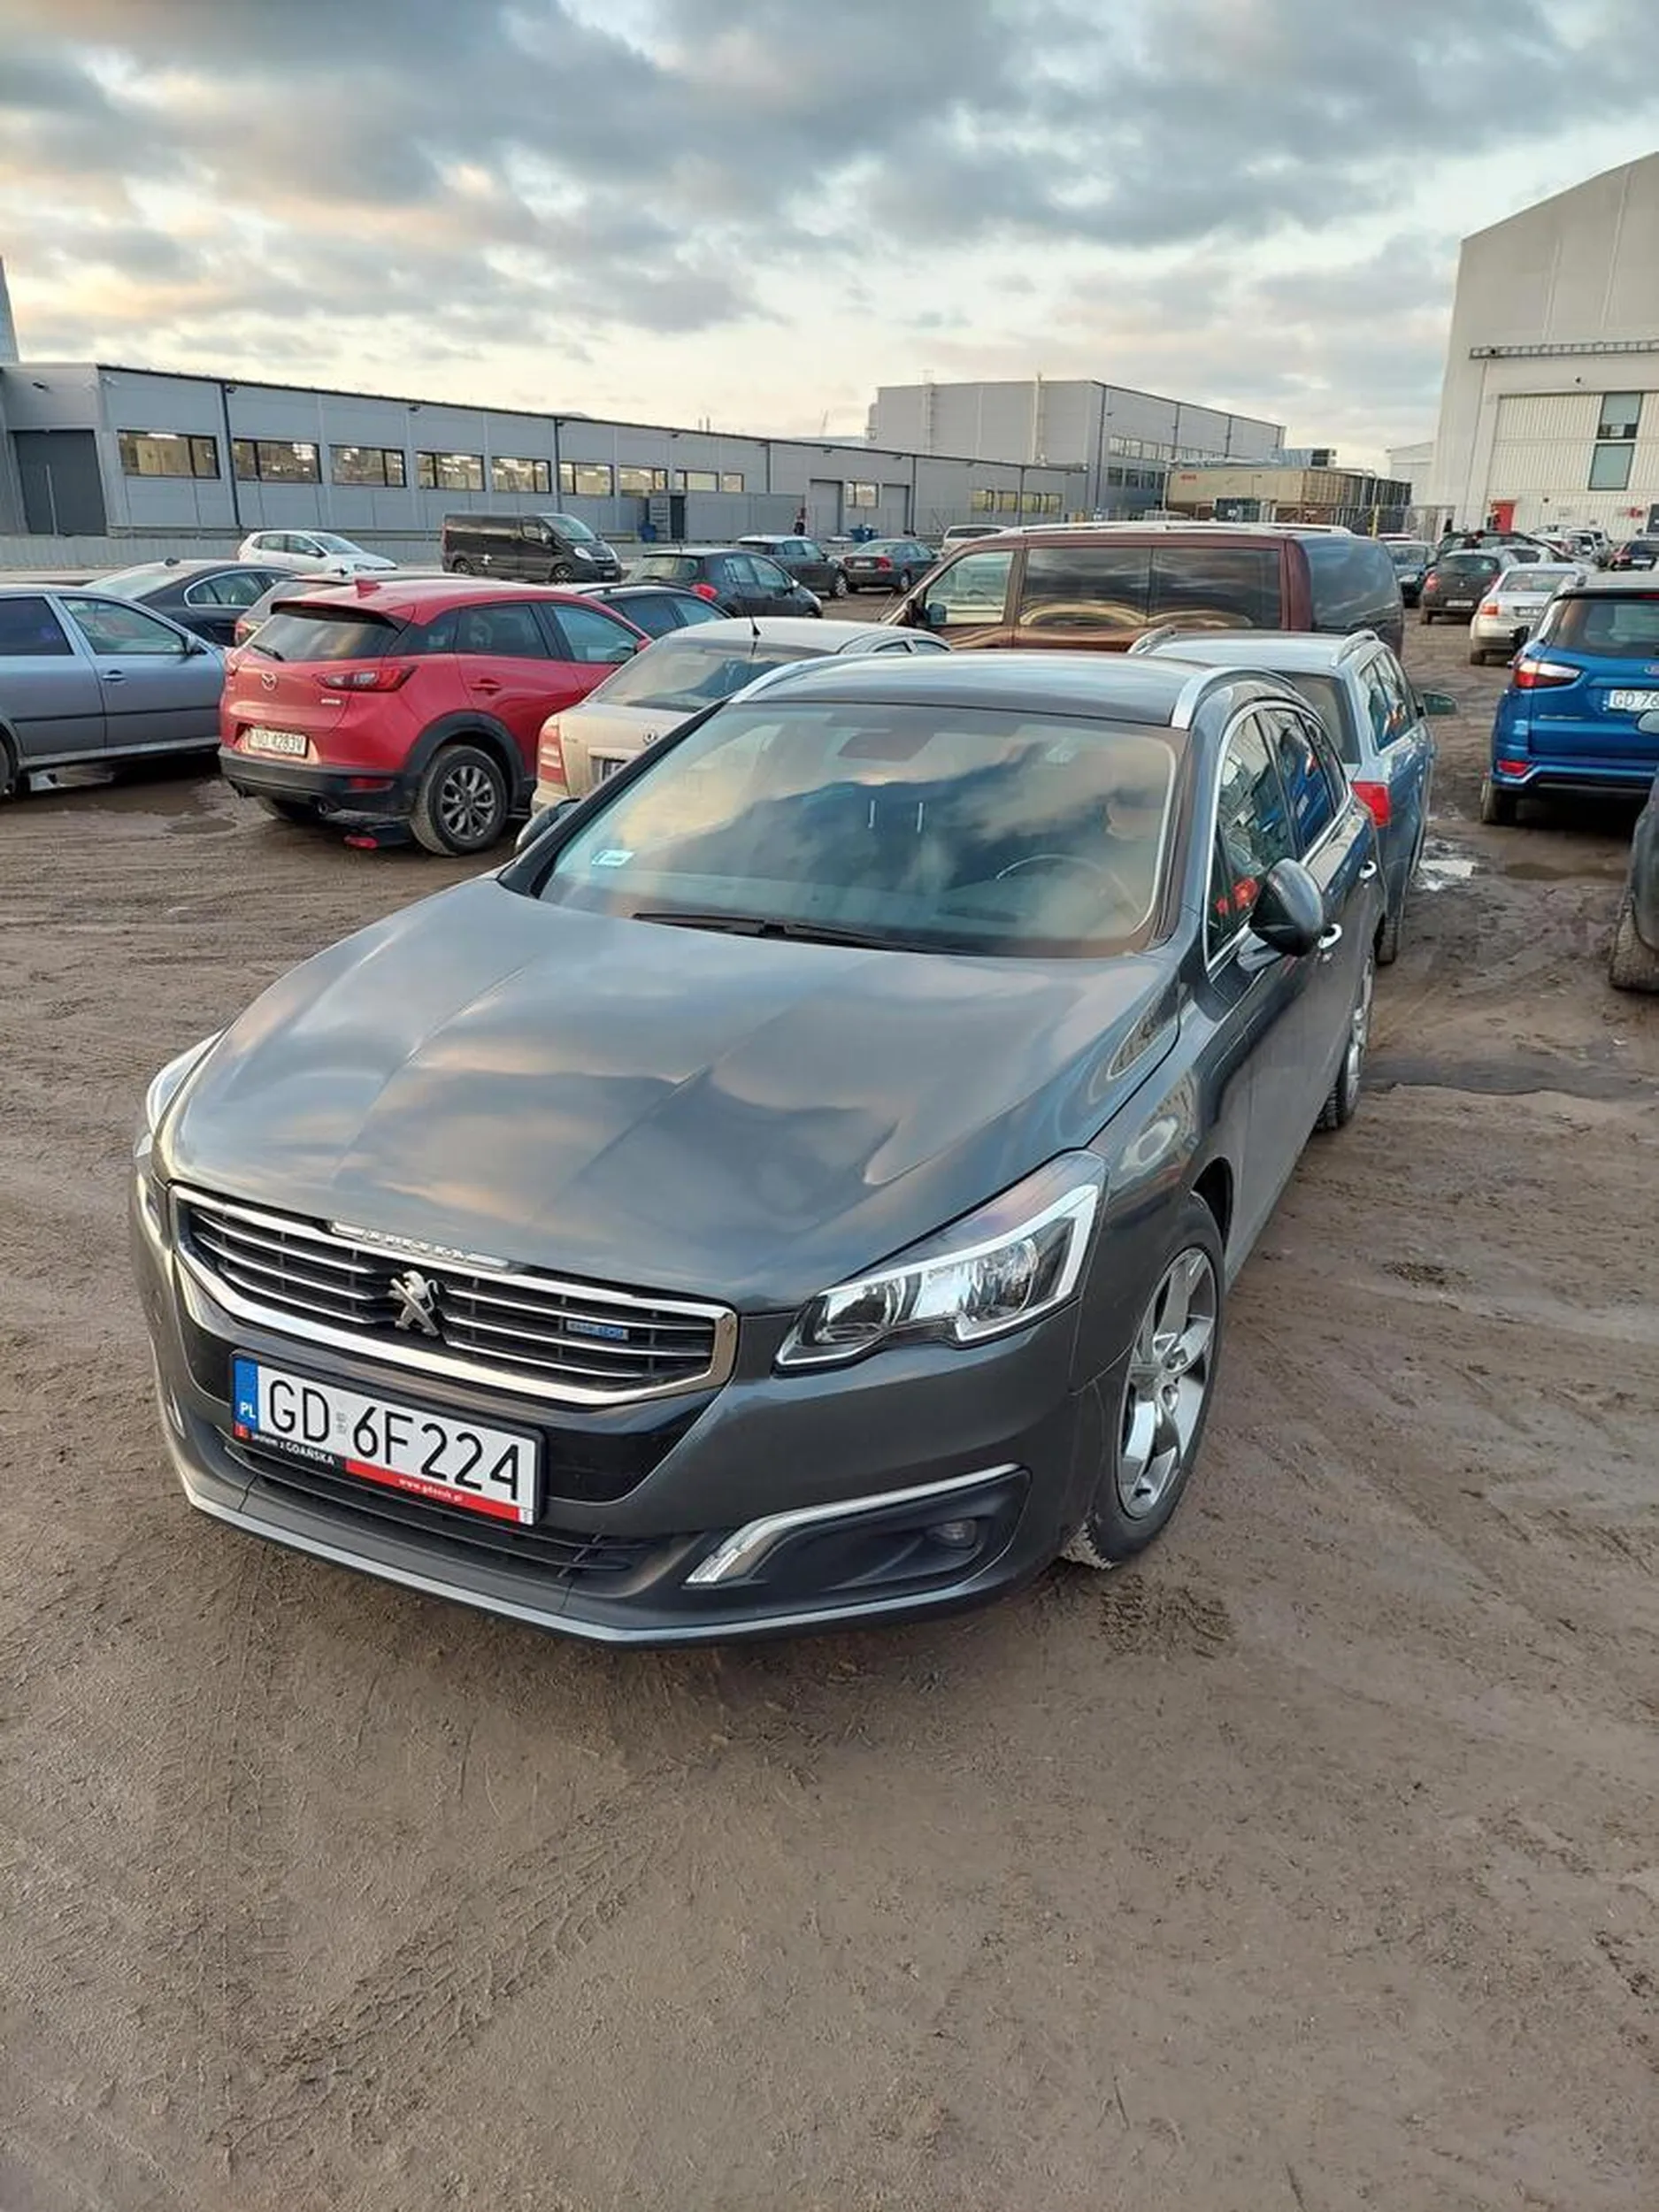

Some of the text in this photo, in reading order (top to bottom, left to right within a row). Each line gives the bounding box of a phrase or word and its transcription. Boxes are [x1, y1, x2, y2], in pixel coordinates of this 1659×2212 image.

[240, 1402, 257, 1418] PL
[269, 1379, 519, 1501] GD 6F224
